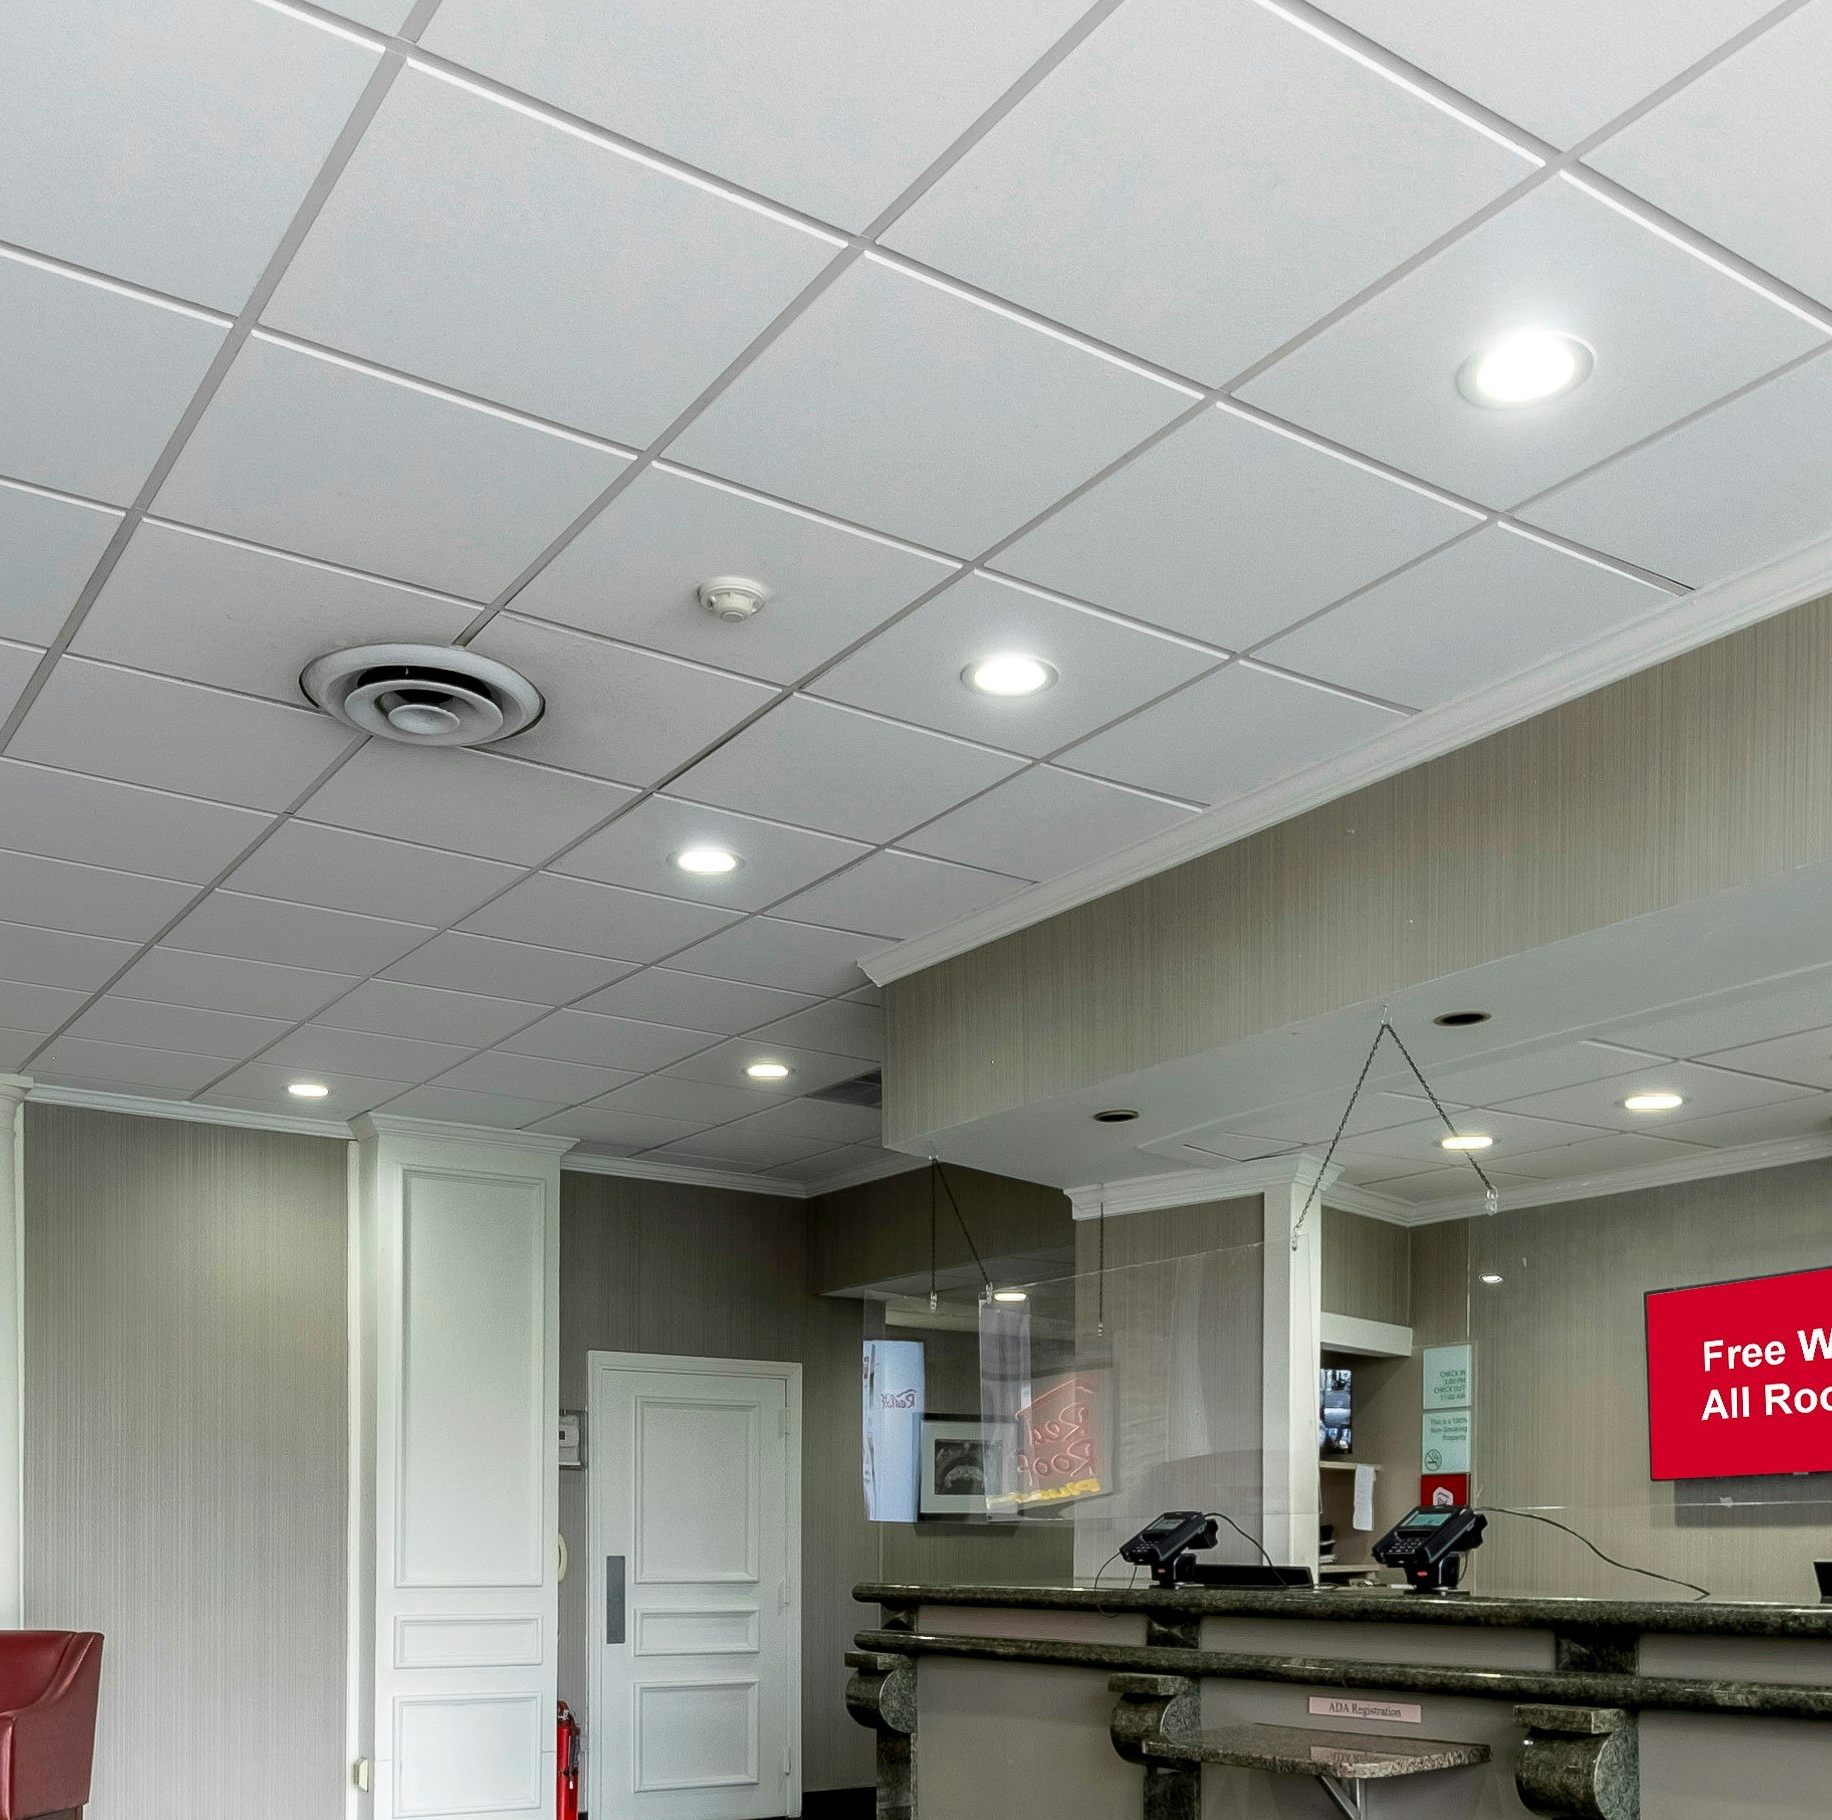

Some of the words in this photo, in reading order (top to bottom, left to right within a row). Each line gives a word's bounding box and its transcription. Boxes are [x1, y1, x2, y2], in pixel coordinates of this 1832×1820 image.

[1703, 1339, 1786, 1372] Free
[1701, 1385, 1750, 1421] All
[1329, 1701, 1350, 1714] ADA
[1352, 1703, 1402, 1718] Registration
